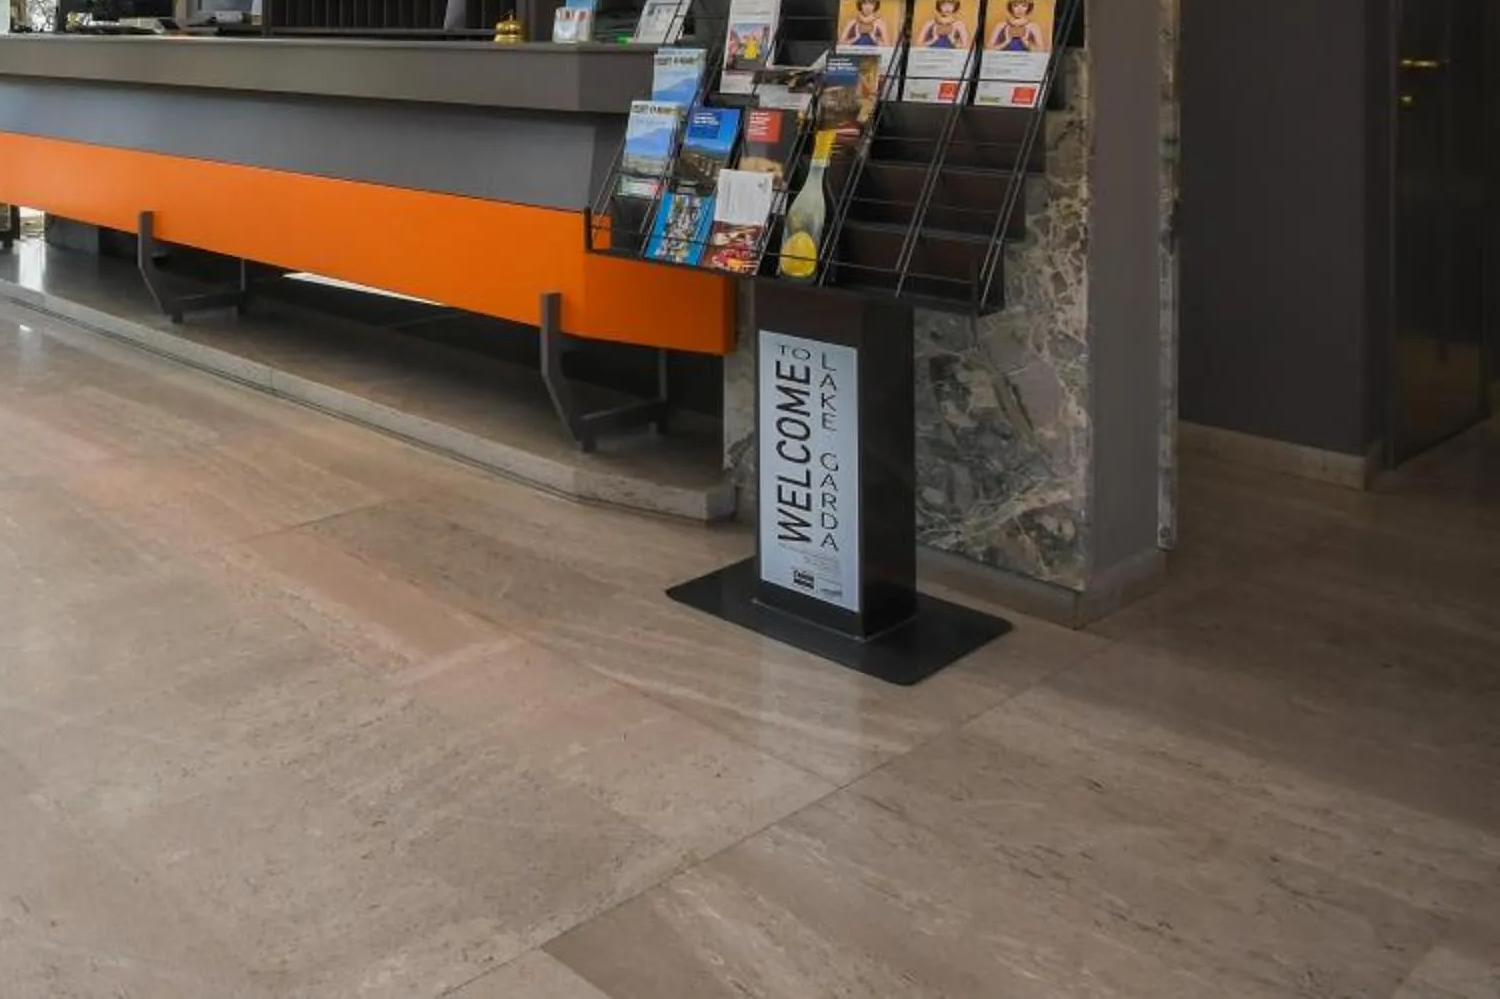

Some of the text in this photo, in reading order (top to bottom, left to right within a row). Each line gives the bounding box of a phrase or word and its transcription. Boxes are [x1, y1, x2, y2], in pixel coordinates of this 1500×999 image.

[778, 344, 811, 361] TO
[820, 352, 837, 432] LAKE
[775, 360, 812, 543] WELCOME
[820, 452, 839, 552] GARDA
